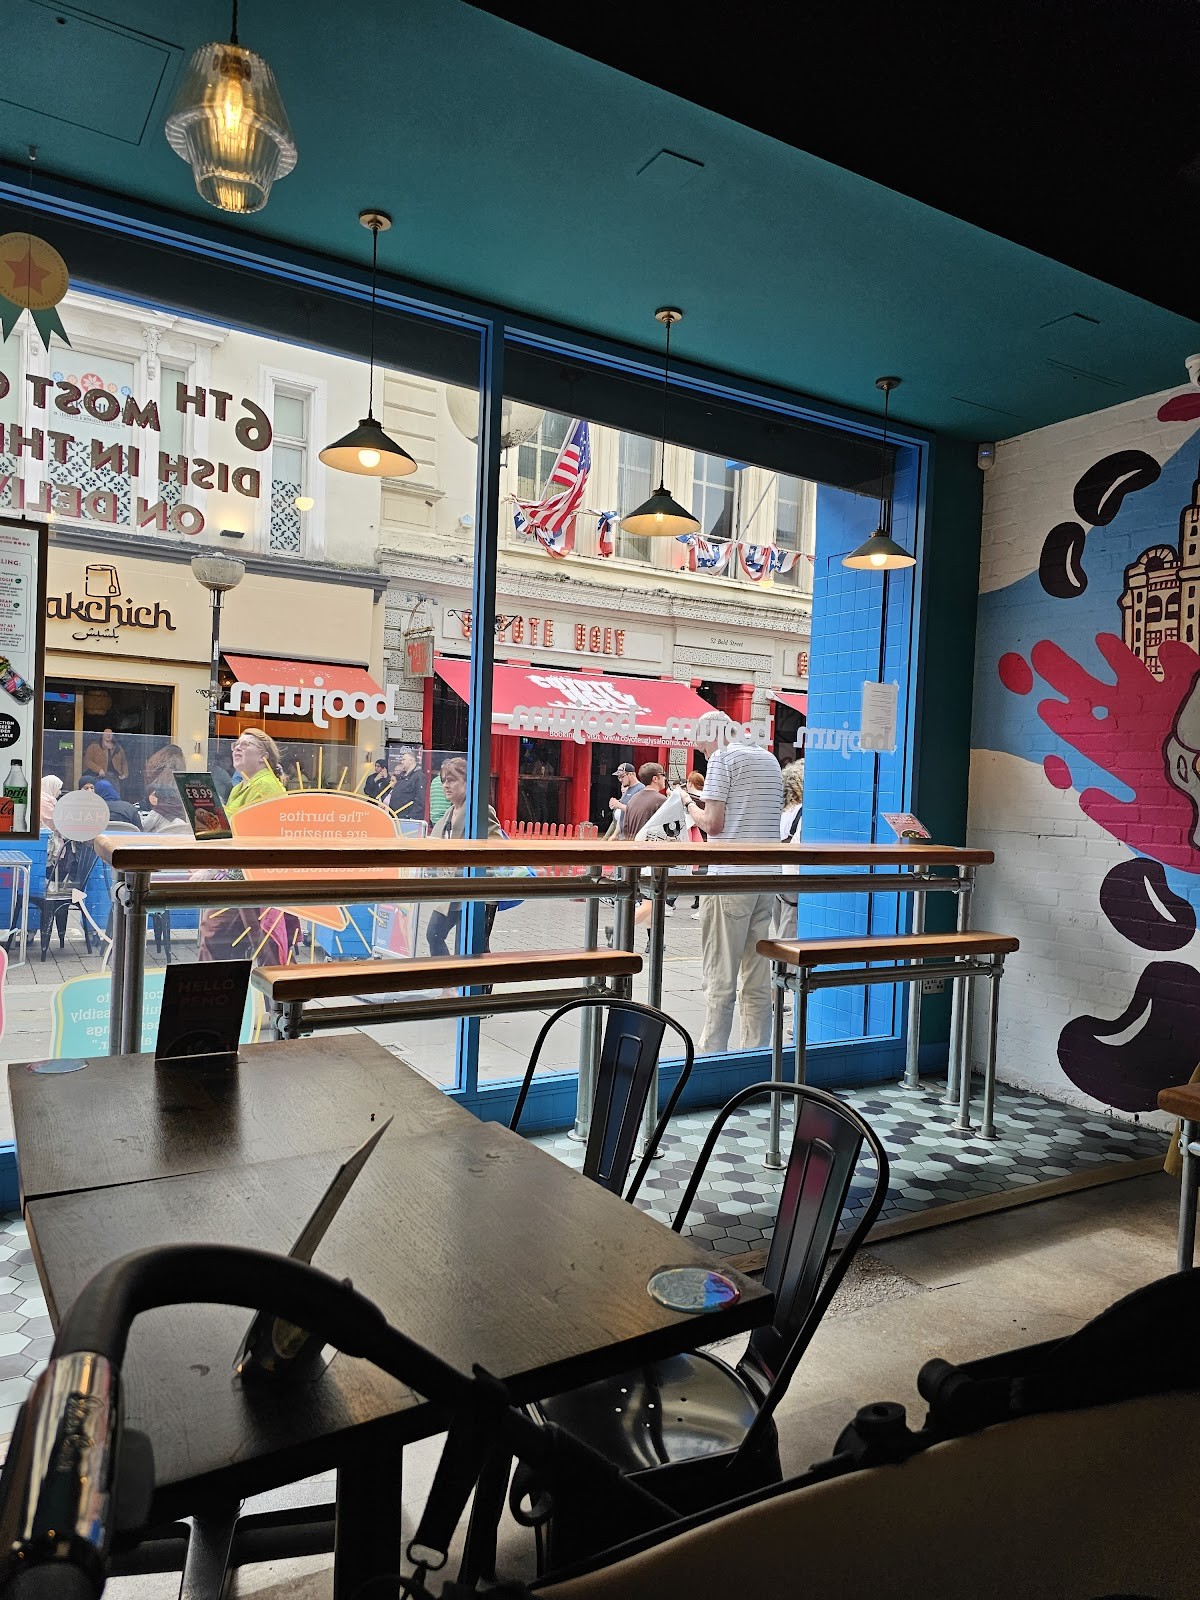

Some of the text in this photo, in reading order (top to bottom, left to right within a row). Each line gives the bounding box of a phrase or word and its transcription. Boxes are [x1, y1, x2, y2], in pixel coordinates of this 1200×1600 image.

[461, 608, 626, 656] CYOTE UGLY
[730, 639, 744, 648] Street
[186, 788, 213, 799] £8.99
